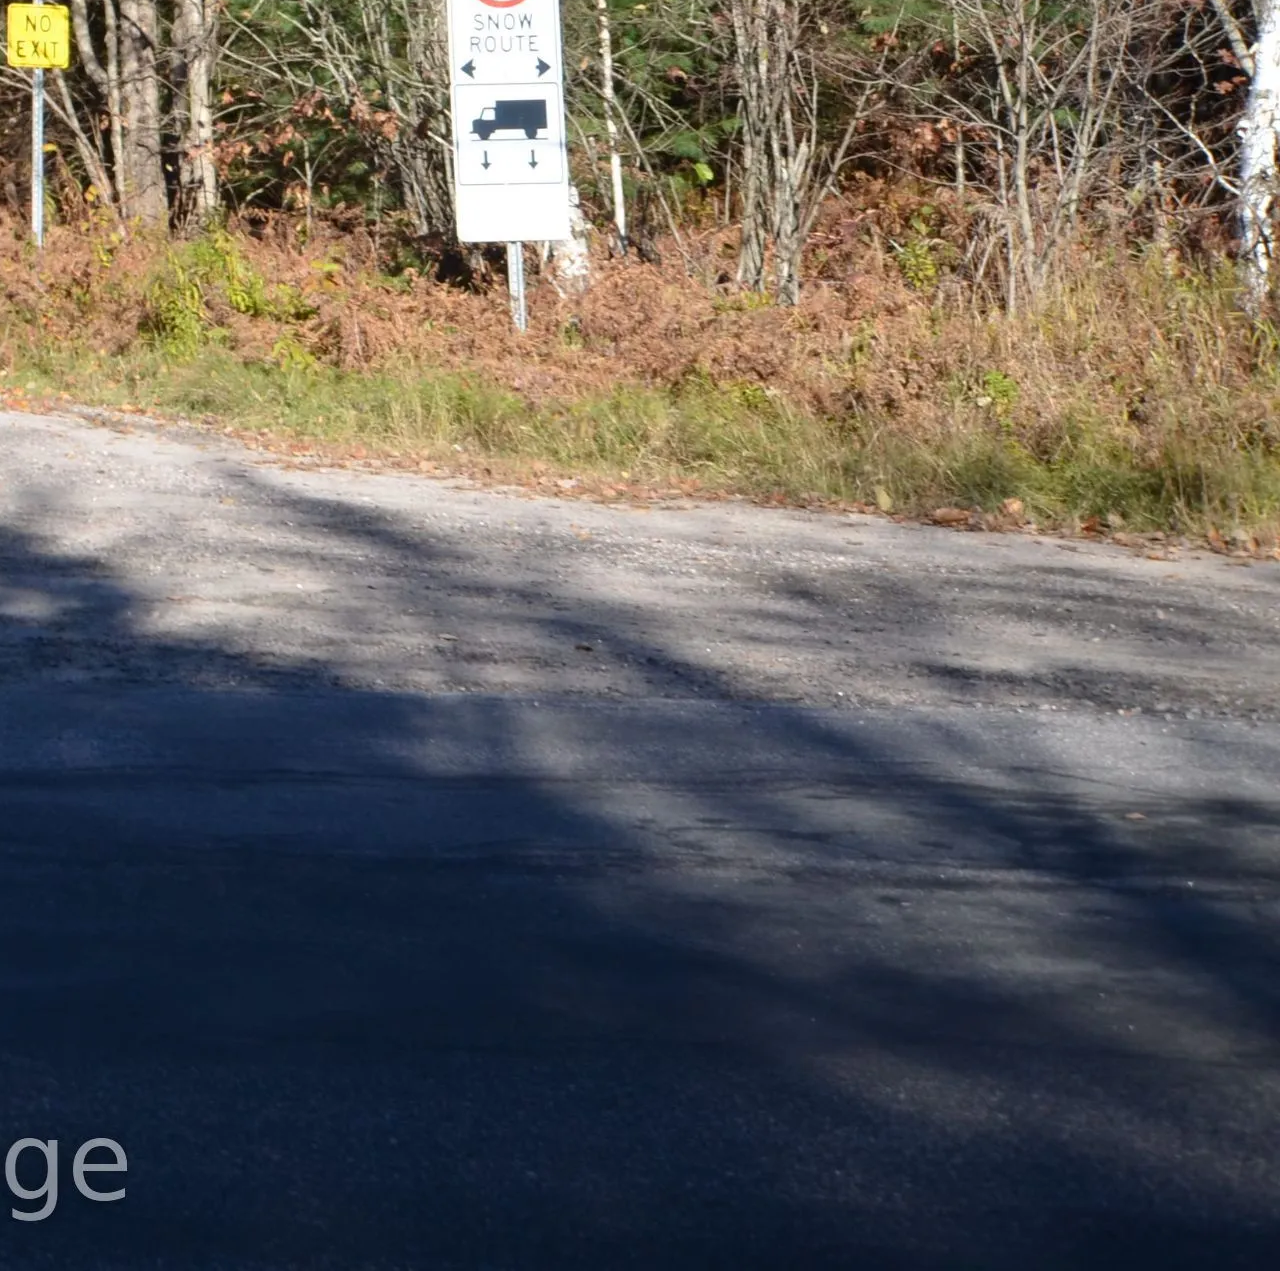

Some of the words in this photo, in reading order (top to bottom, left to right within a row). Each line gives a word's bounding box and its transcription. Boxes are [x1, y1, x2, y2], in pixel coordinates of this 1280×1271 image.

[25, 14, 51, 33] NO
[473, 13, 533, 31] SNOW
[16, 40, 58, 59] EXIT
[470, 35, 539, 53] ROUTE
